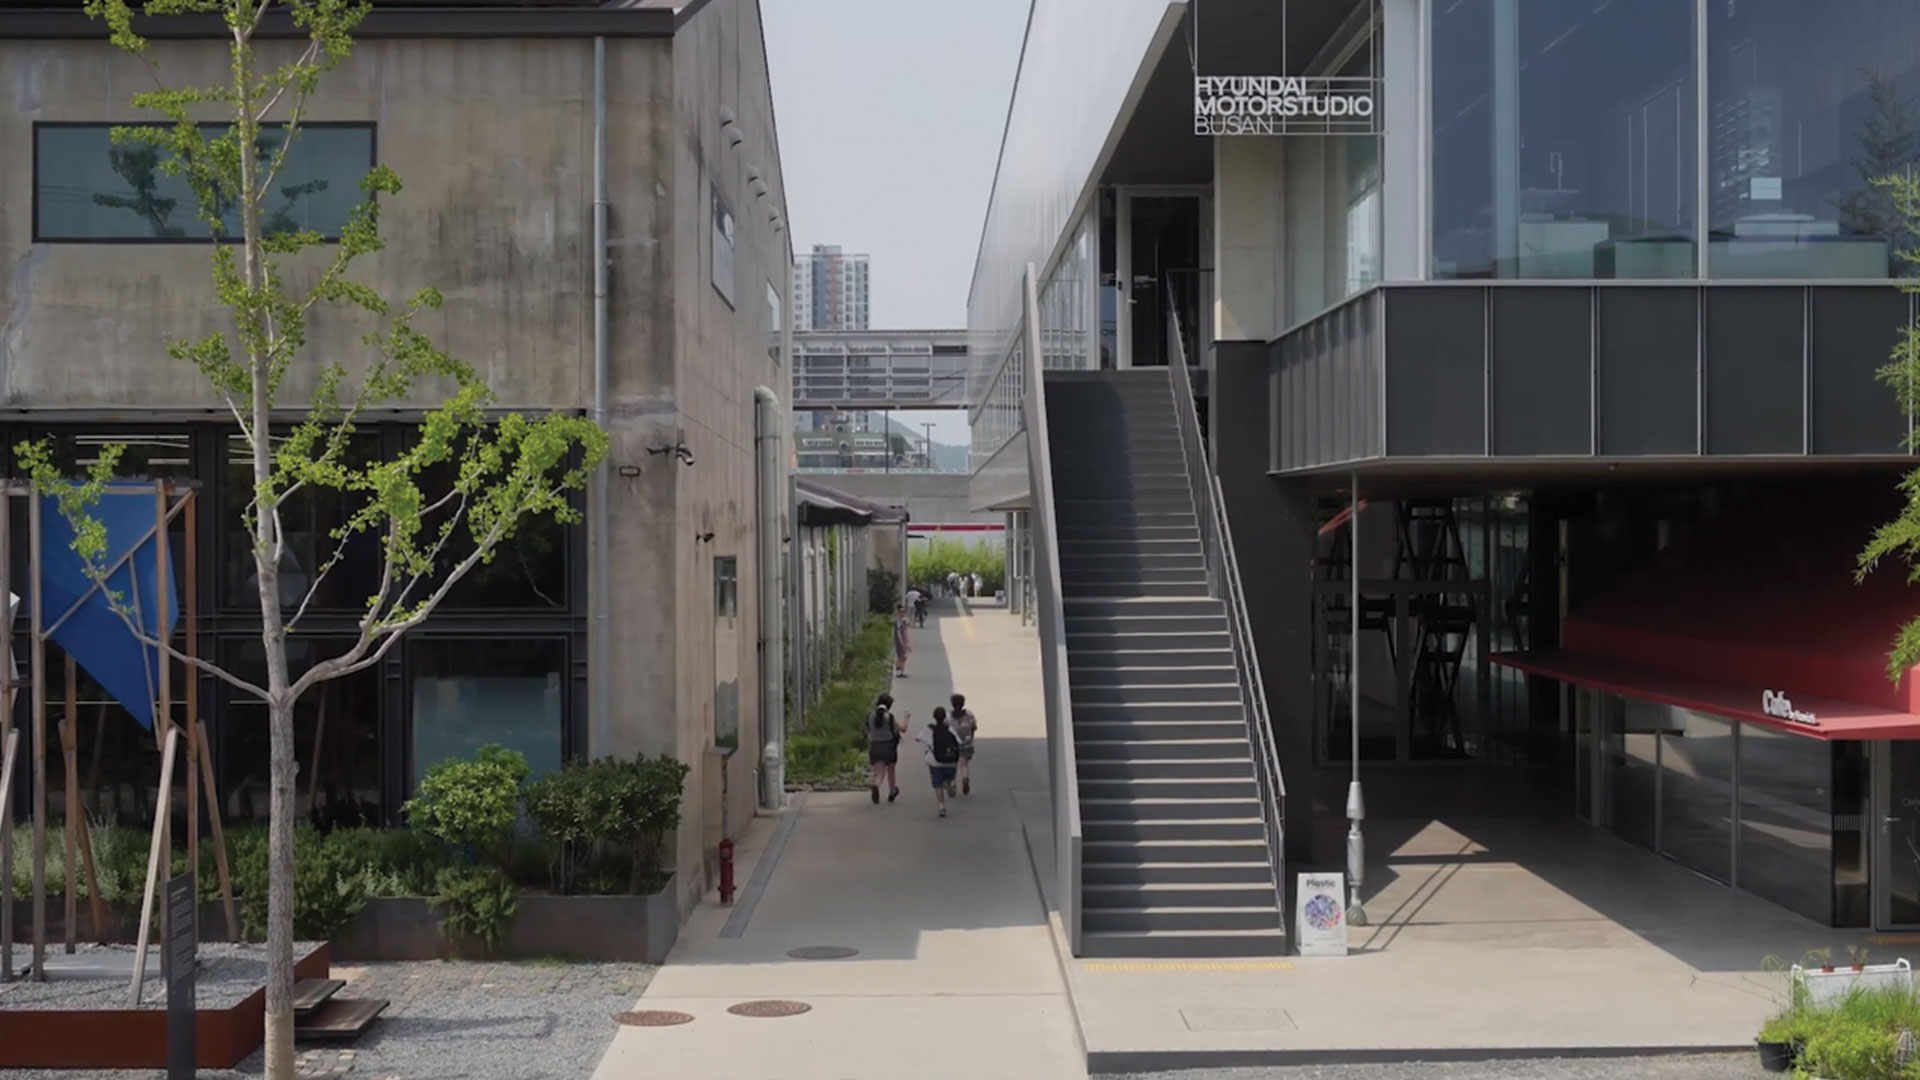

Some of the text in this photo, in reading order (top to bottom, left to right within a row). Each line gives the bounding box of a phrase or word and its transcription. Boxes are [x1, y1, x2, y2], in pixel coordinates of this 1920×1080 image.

[1196, 76, 1306, 96] HYUNDAI
[1196, 96, 1374, 116] MOTORSTUDIO
[1195, 116, 1274, 135] BUSAN
[1306, 879, 1336, 888] Plastic
